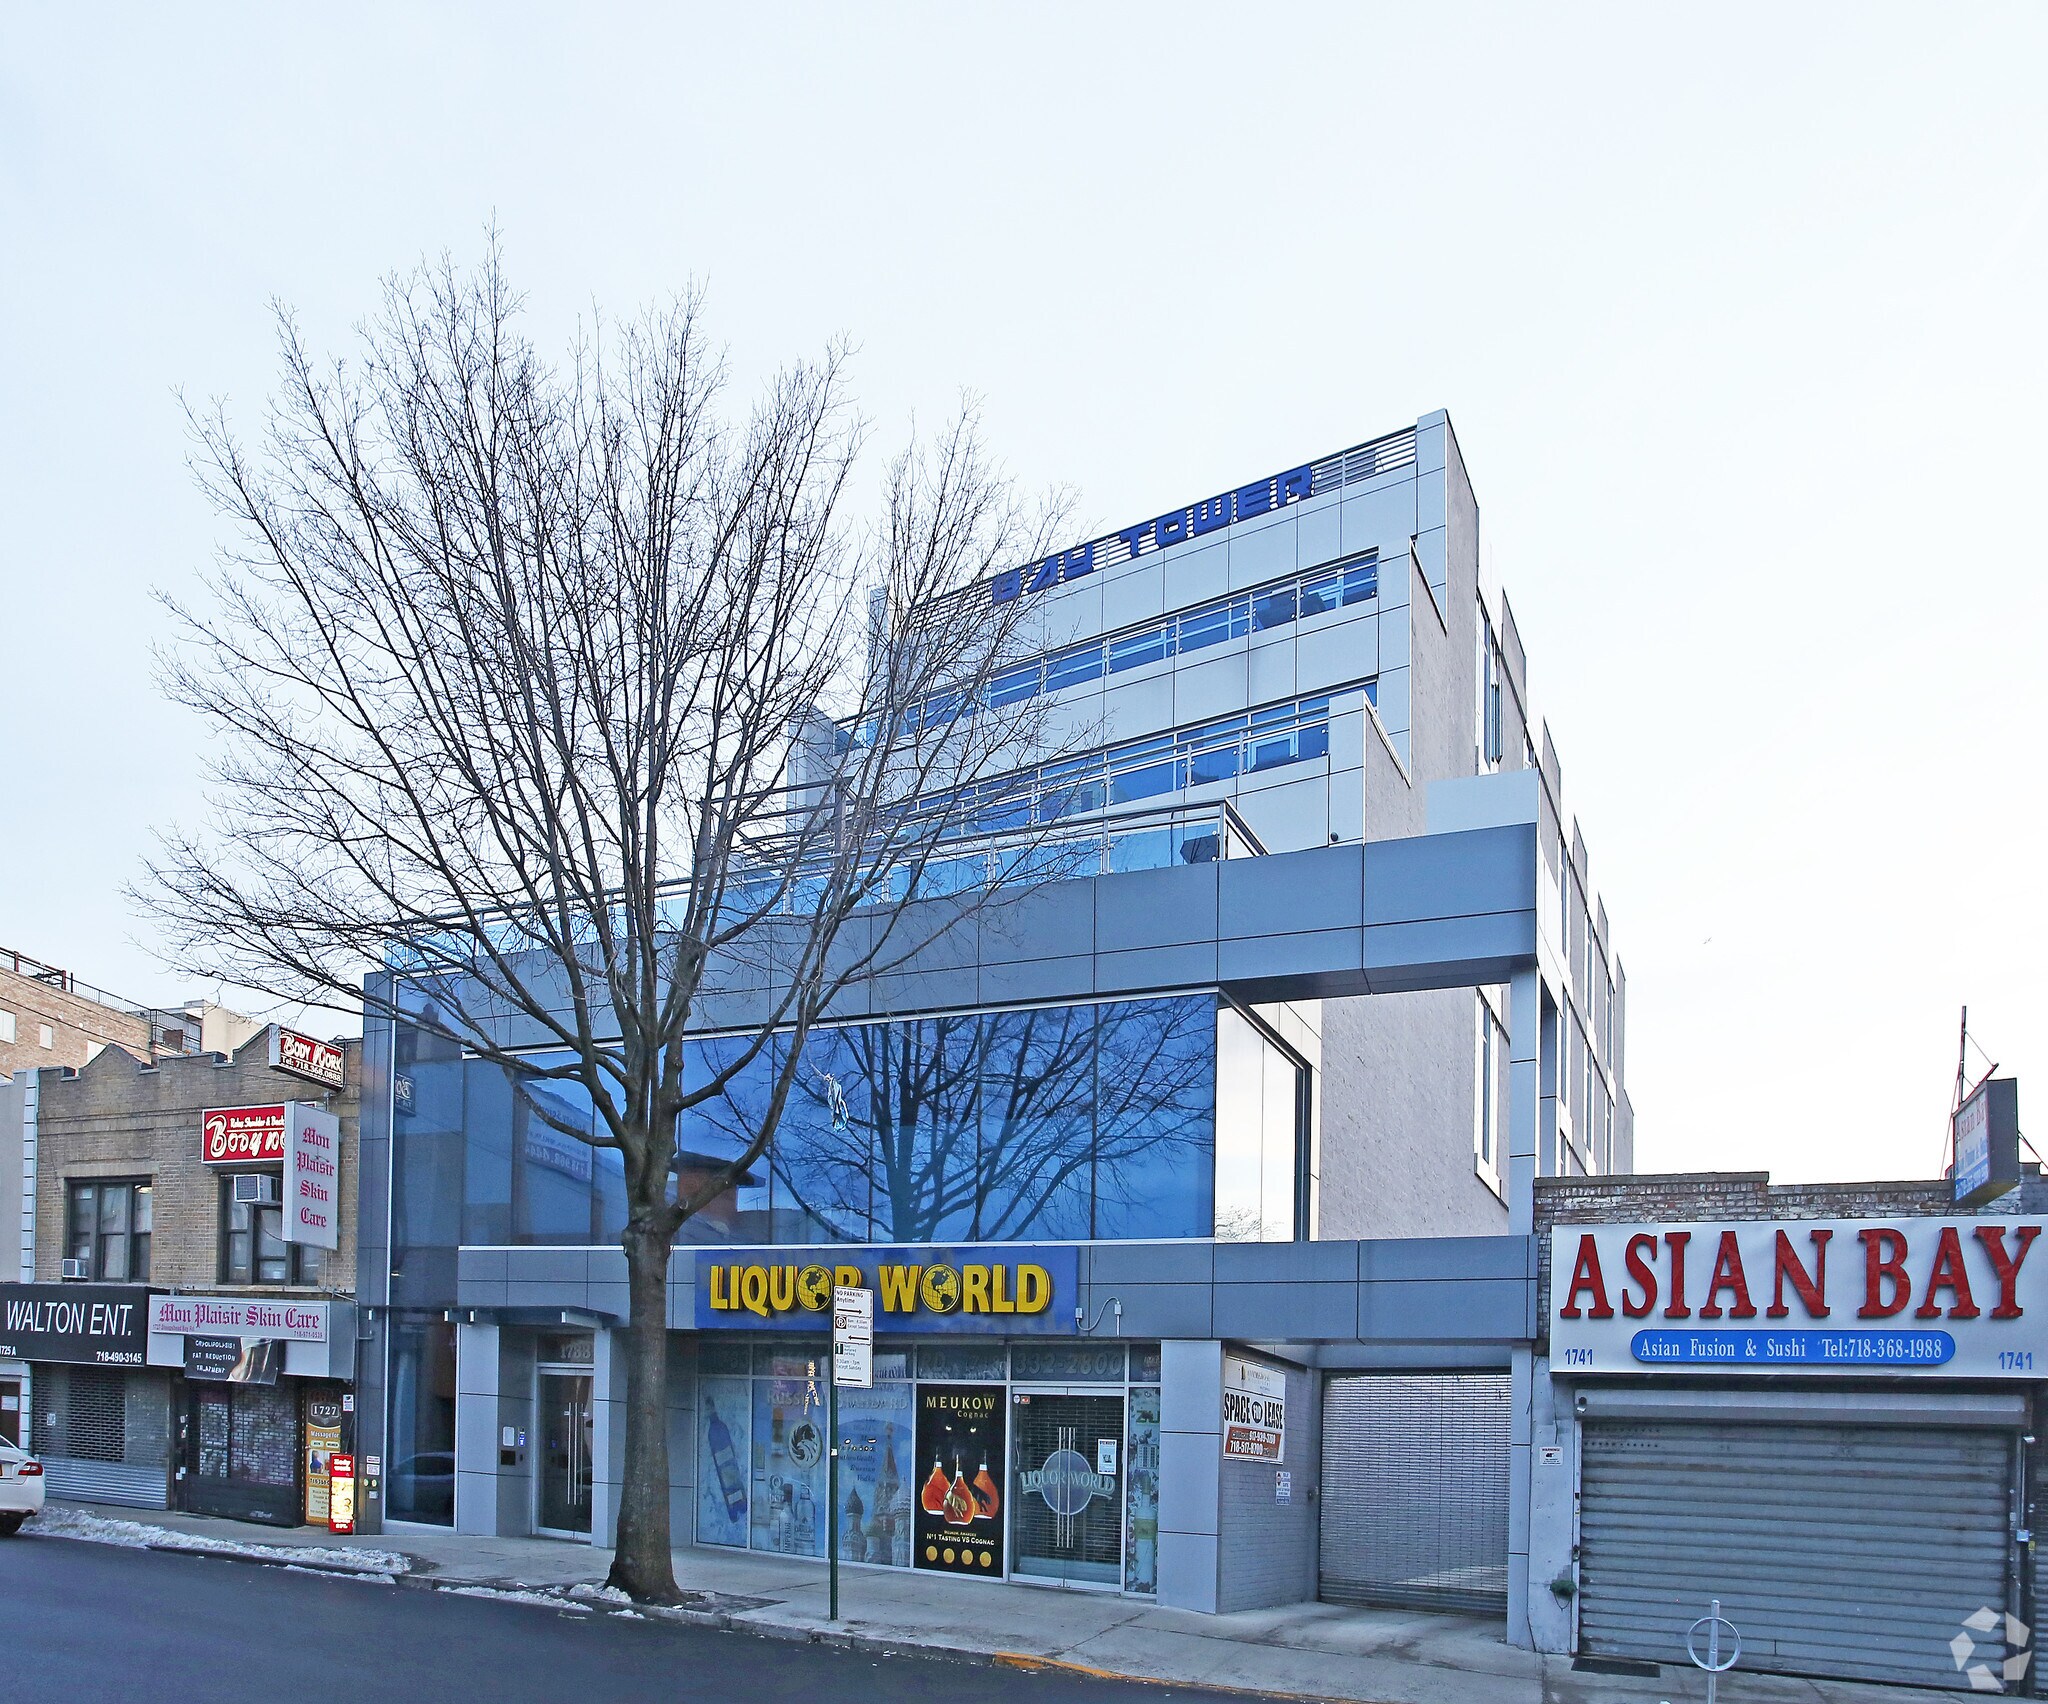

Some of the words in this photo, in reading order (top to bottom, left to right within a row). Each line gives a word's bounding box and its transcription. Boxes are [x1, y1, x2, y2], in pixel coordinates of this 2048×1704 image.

[1119, 465, 1314, 557] TOWER
[281, 1056, 294, 1067] Tel:
[302, 1127, 330, 1149] Mon
[297, 1151, 335, 1177] Plaisir
[300, 1179, 328, 1202] Skin
[301, 1207, 327, 1228] Care
[1560, 1229, 1833, 1319] ASIAN
[1857, 1226, 2042, 1319] BAY
[710, 1264, 862, 1318] LIQUOR
[878, 1263, 1050, 1314] WORLD
[7, 1300, 86, 1334] WALTON
[89, 1303, 133, 1336] ENT.
[159, 1303, 191, 1323] Mon
[195, 1303, 242, 1328] Plaisir
[245, 1305, 282, 1327] Skin
[285, 1307, 320, 1329] Care
[96, 1351, 142, 1363] 718-490-3145
[1565, 1349, 1593, 1365] 1741
[1641, 1338, 1680, 1357] Asian
[1690, 1338, 1735, 1357] Fusion
[1745, 1338, 1757, 1357] &
[1766, 1338, 1805, 1357] Sushi
[1999, 1351, 2033, 1370] 1741
[313, 1405, 337, 1416] 1727
[926, 1396, 995, 1410] MEUKOW
[957, 1410, 989, 1419] Cognac
[1224, 1392, 1251, 1424] SPACE
[1264, 1400, 1283, 1429] LEASE
[1020, 1469, 1066, 1491] LIQUOR
[1070, 1471, 1116, 1495] WORLD
[938, 1534, 961, 1543] TASTING
[970, 1537, 995, 1546] COGNAC
